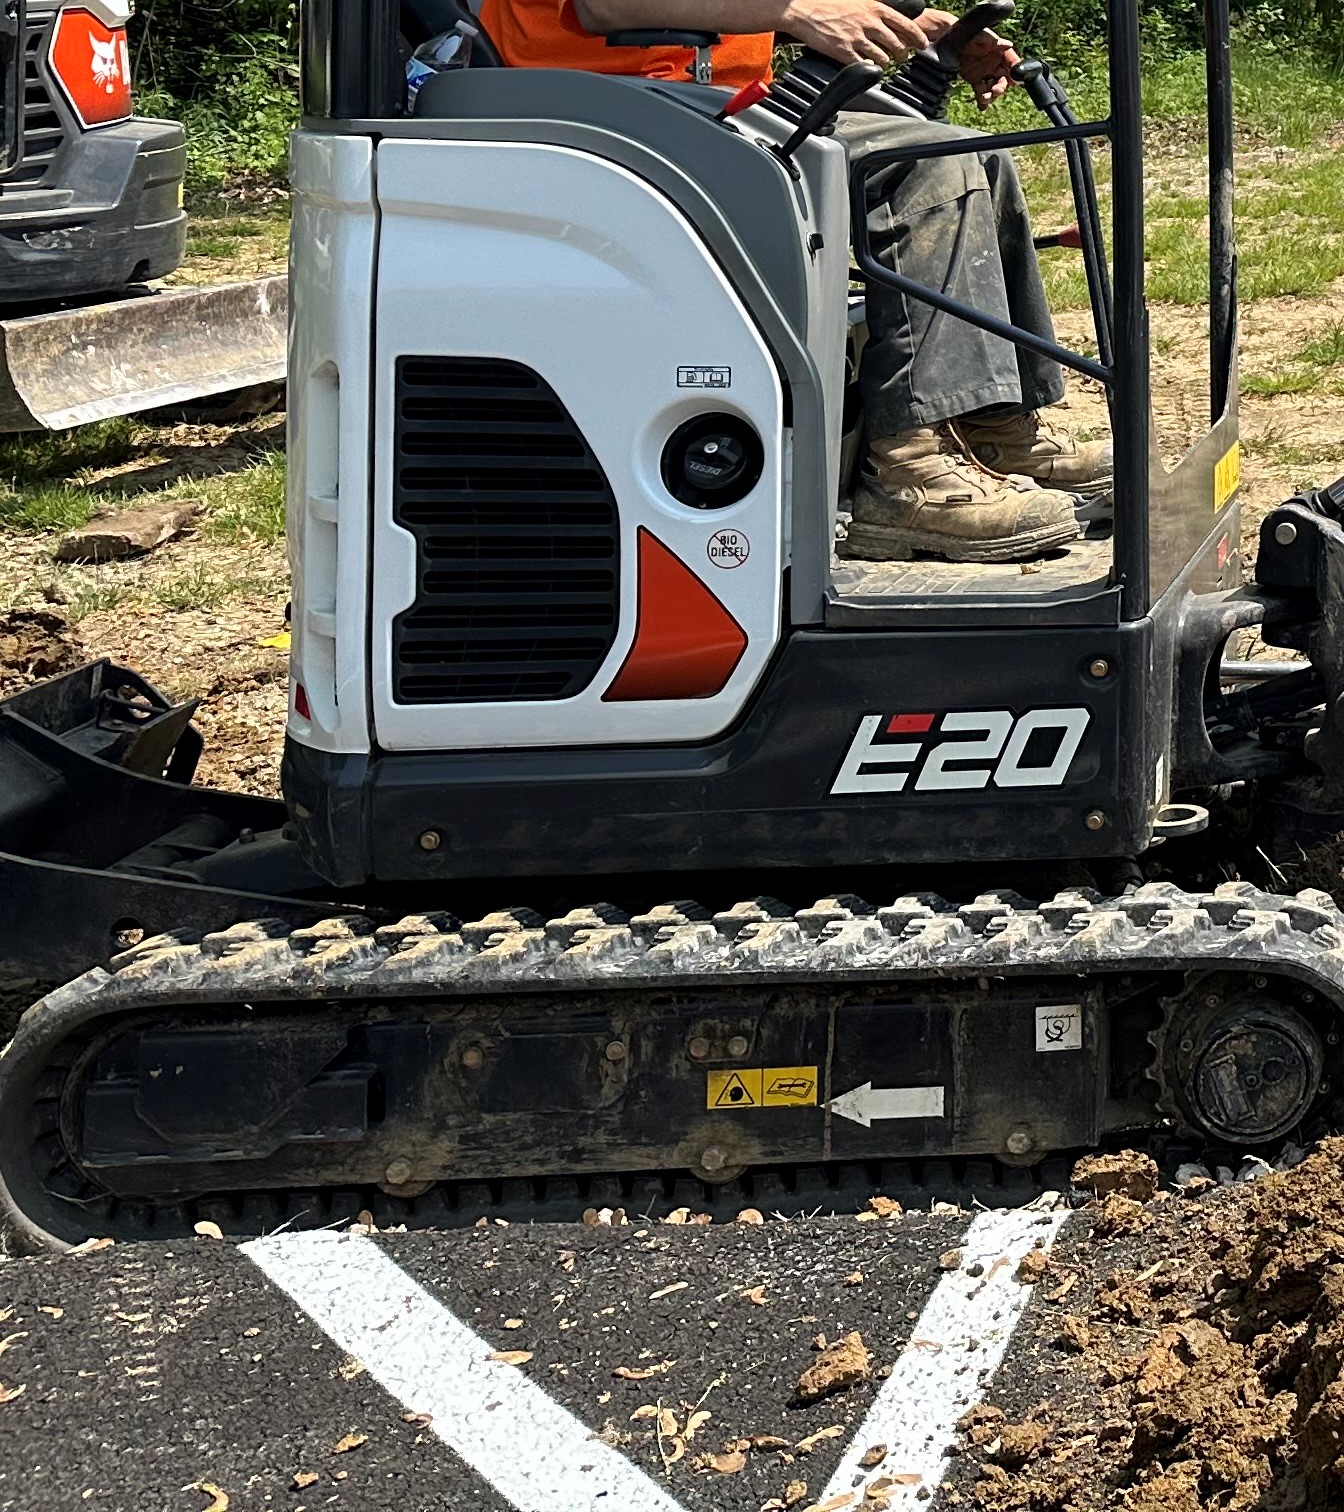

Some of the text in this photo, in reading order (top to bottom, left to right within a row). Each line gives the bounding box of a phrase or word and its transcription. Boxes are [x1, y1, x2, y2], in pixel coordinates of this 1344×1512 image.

[689, 460, 722, 475] DIESEL
[720, 535, 737, 545] BIO
[711, 546, 745, 557] DIESEL
[830, 708, 1091, 794] E20
